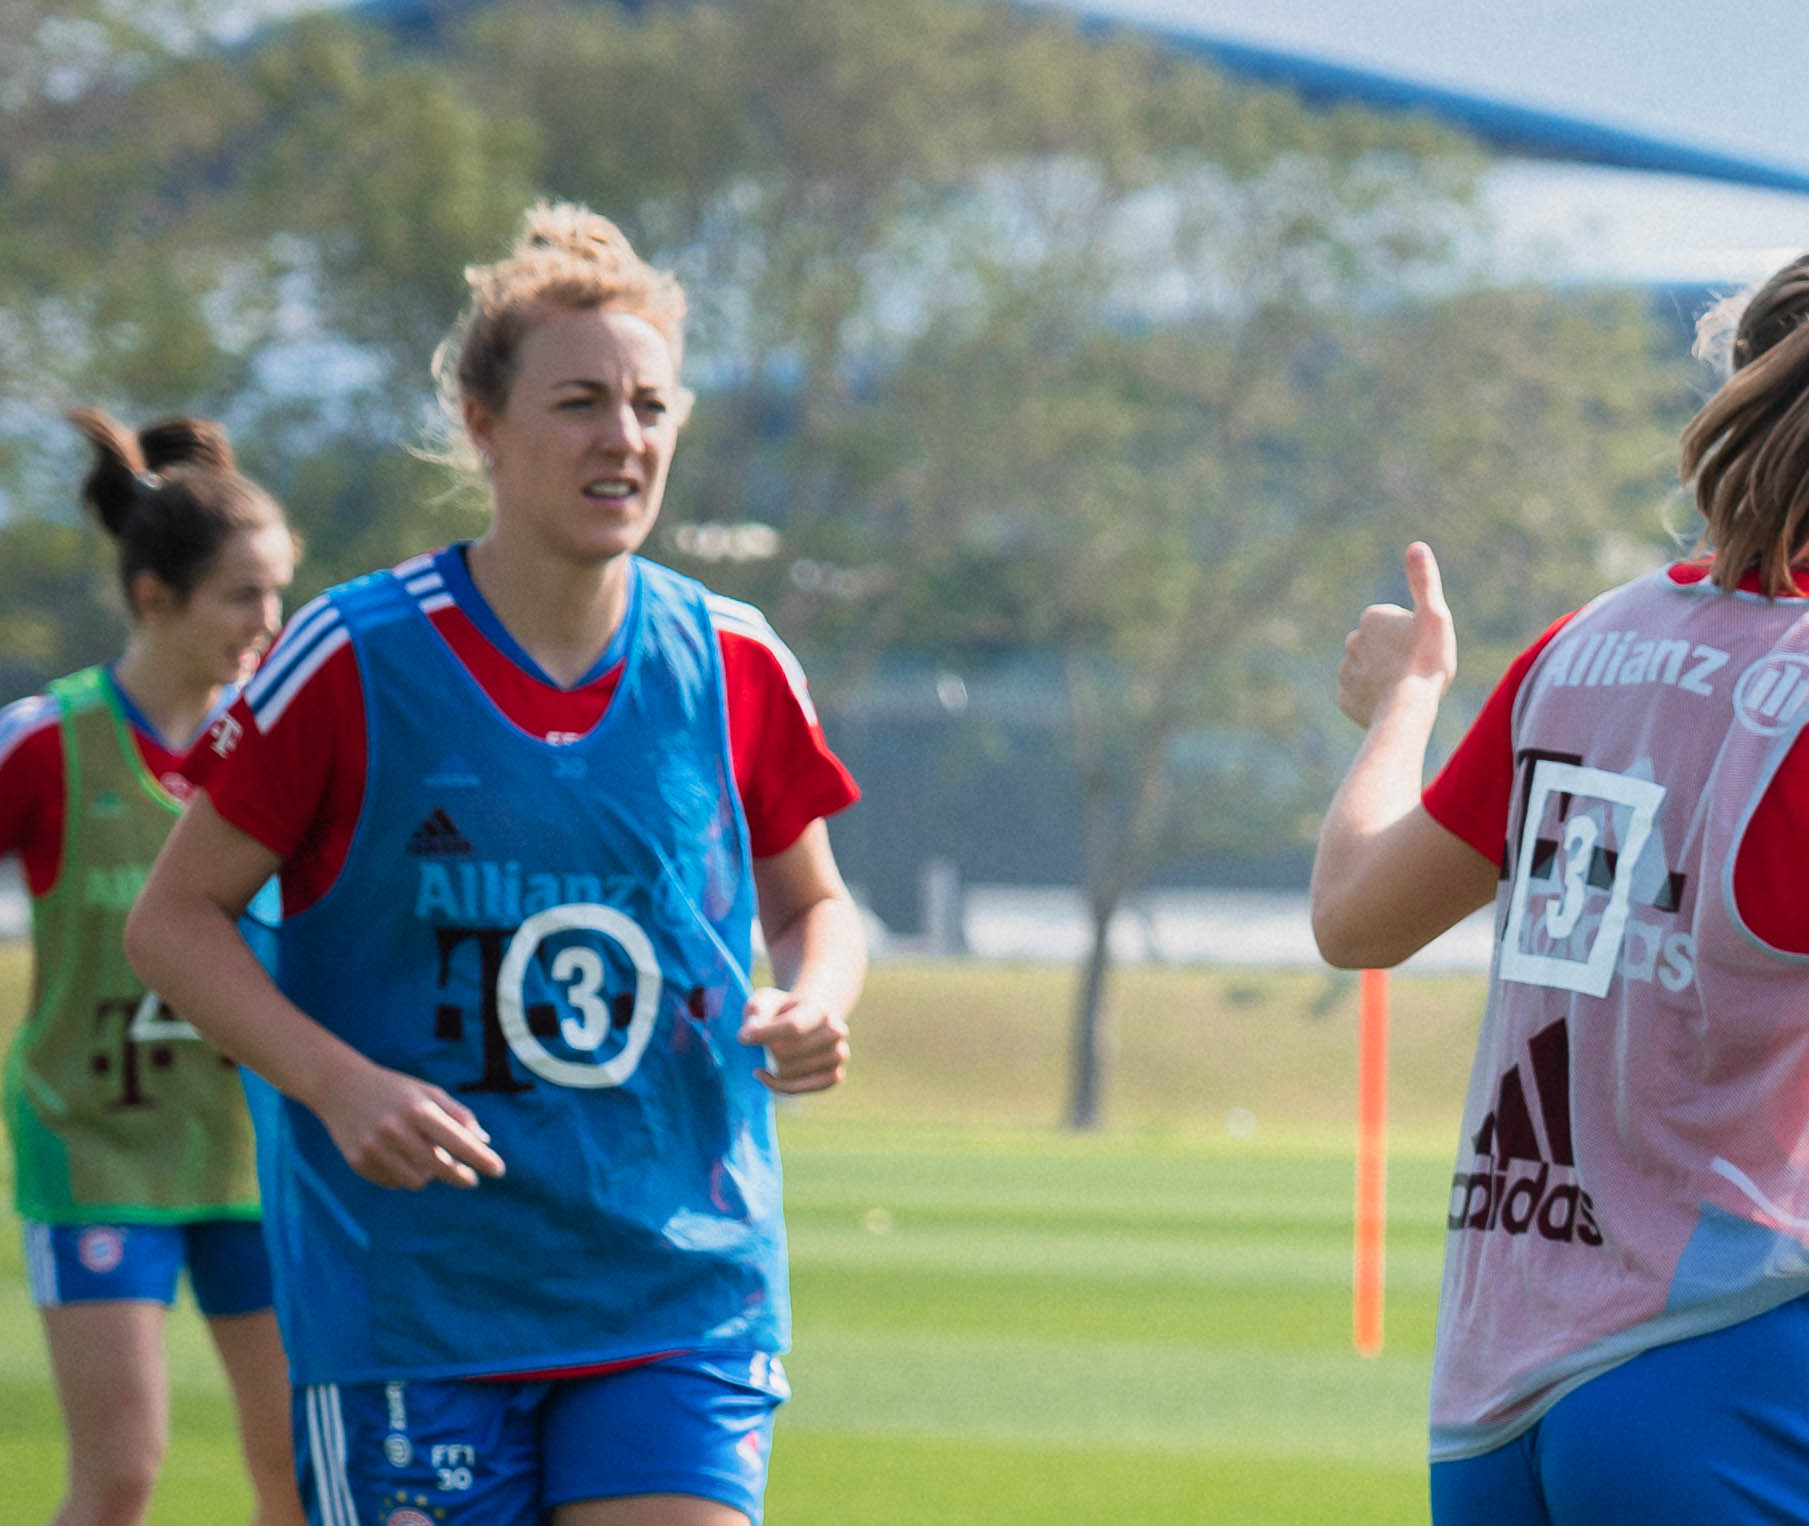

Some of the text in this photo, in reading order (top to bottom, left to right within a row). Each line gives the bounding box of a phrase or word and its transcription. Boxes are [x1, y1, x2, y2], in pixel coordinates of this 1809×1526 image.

[1548, 630, 1730, 697] Allianz
[415, 861, 637, 926] Allianz
[1545, 813, 1599, 940] 3
[552, 945, 610, 1050] 3
